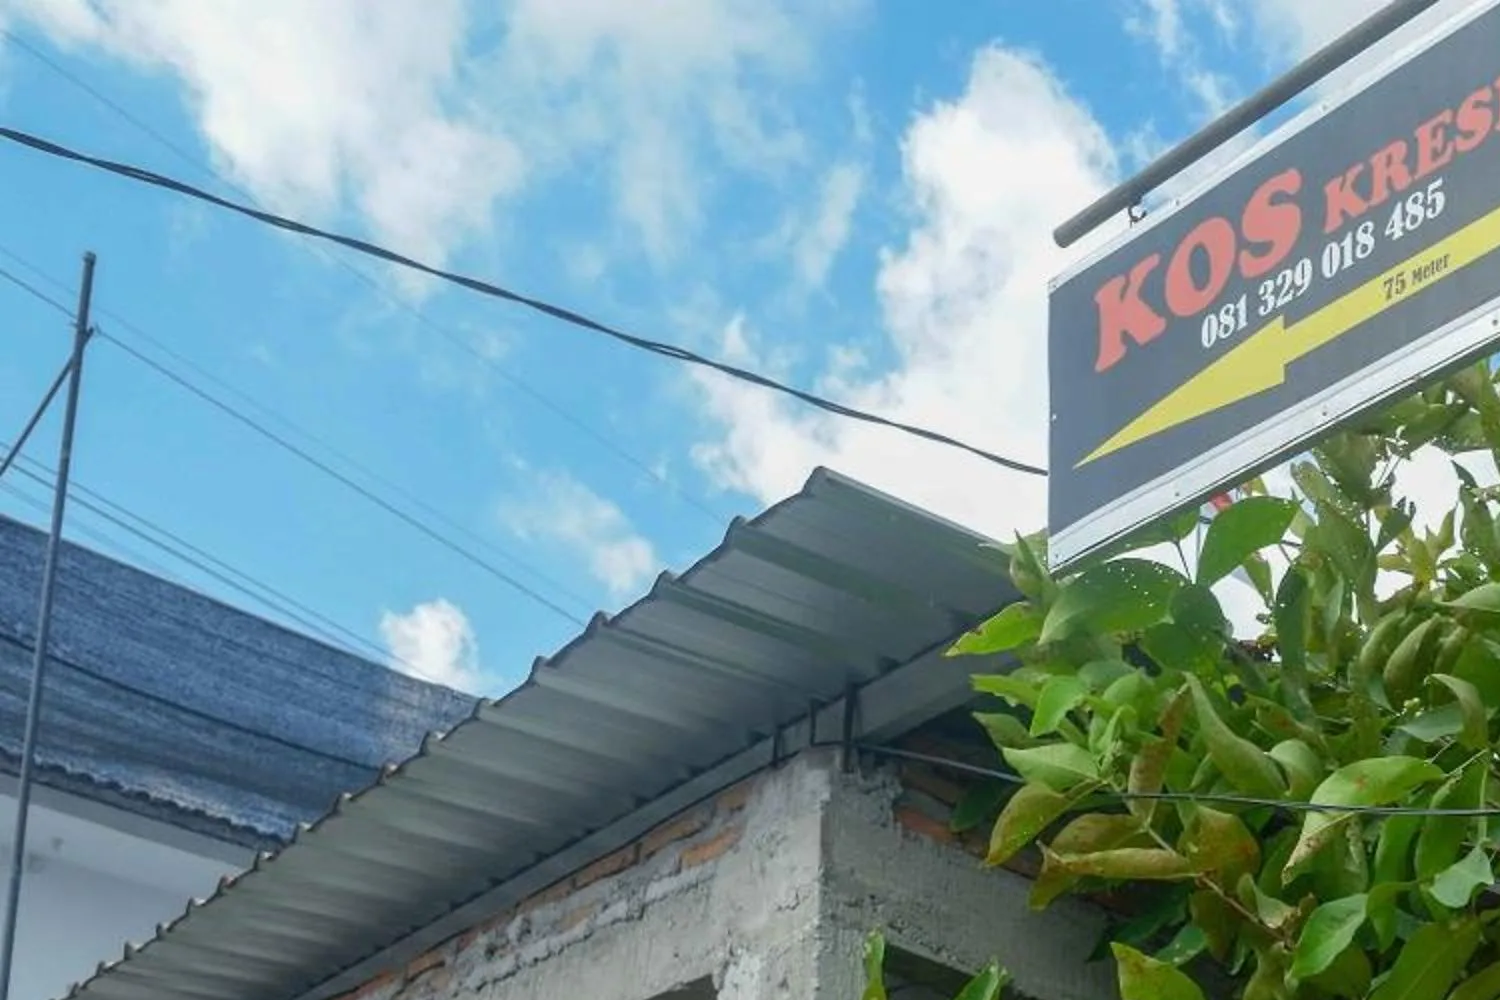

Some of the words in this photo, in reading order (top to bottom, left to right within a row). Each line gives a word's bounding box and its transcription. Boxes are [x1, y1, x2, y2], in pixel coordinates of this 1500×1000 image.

[1095, 170, 1302, 372] KOS
[1201, 293, 1248, 349] 081
[1258, 257, 1313, 317] 329
[1321, 220, 1376, 279] 018
[1385, 177, 1446, 241] 485
[1383, 271, 1407, 301] 75
[1411, 253, 1451, 284] Meter
